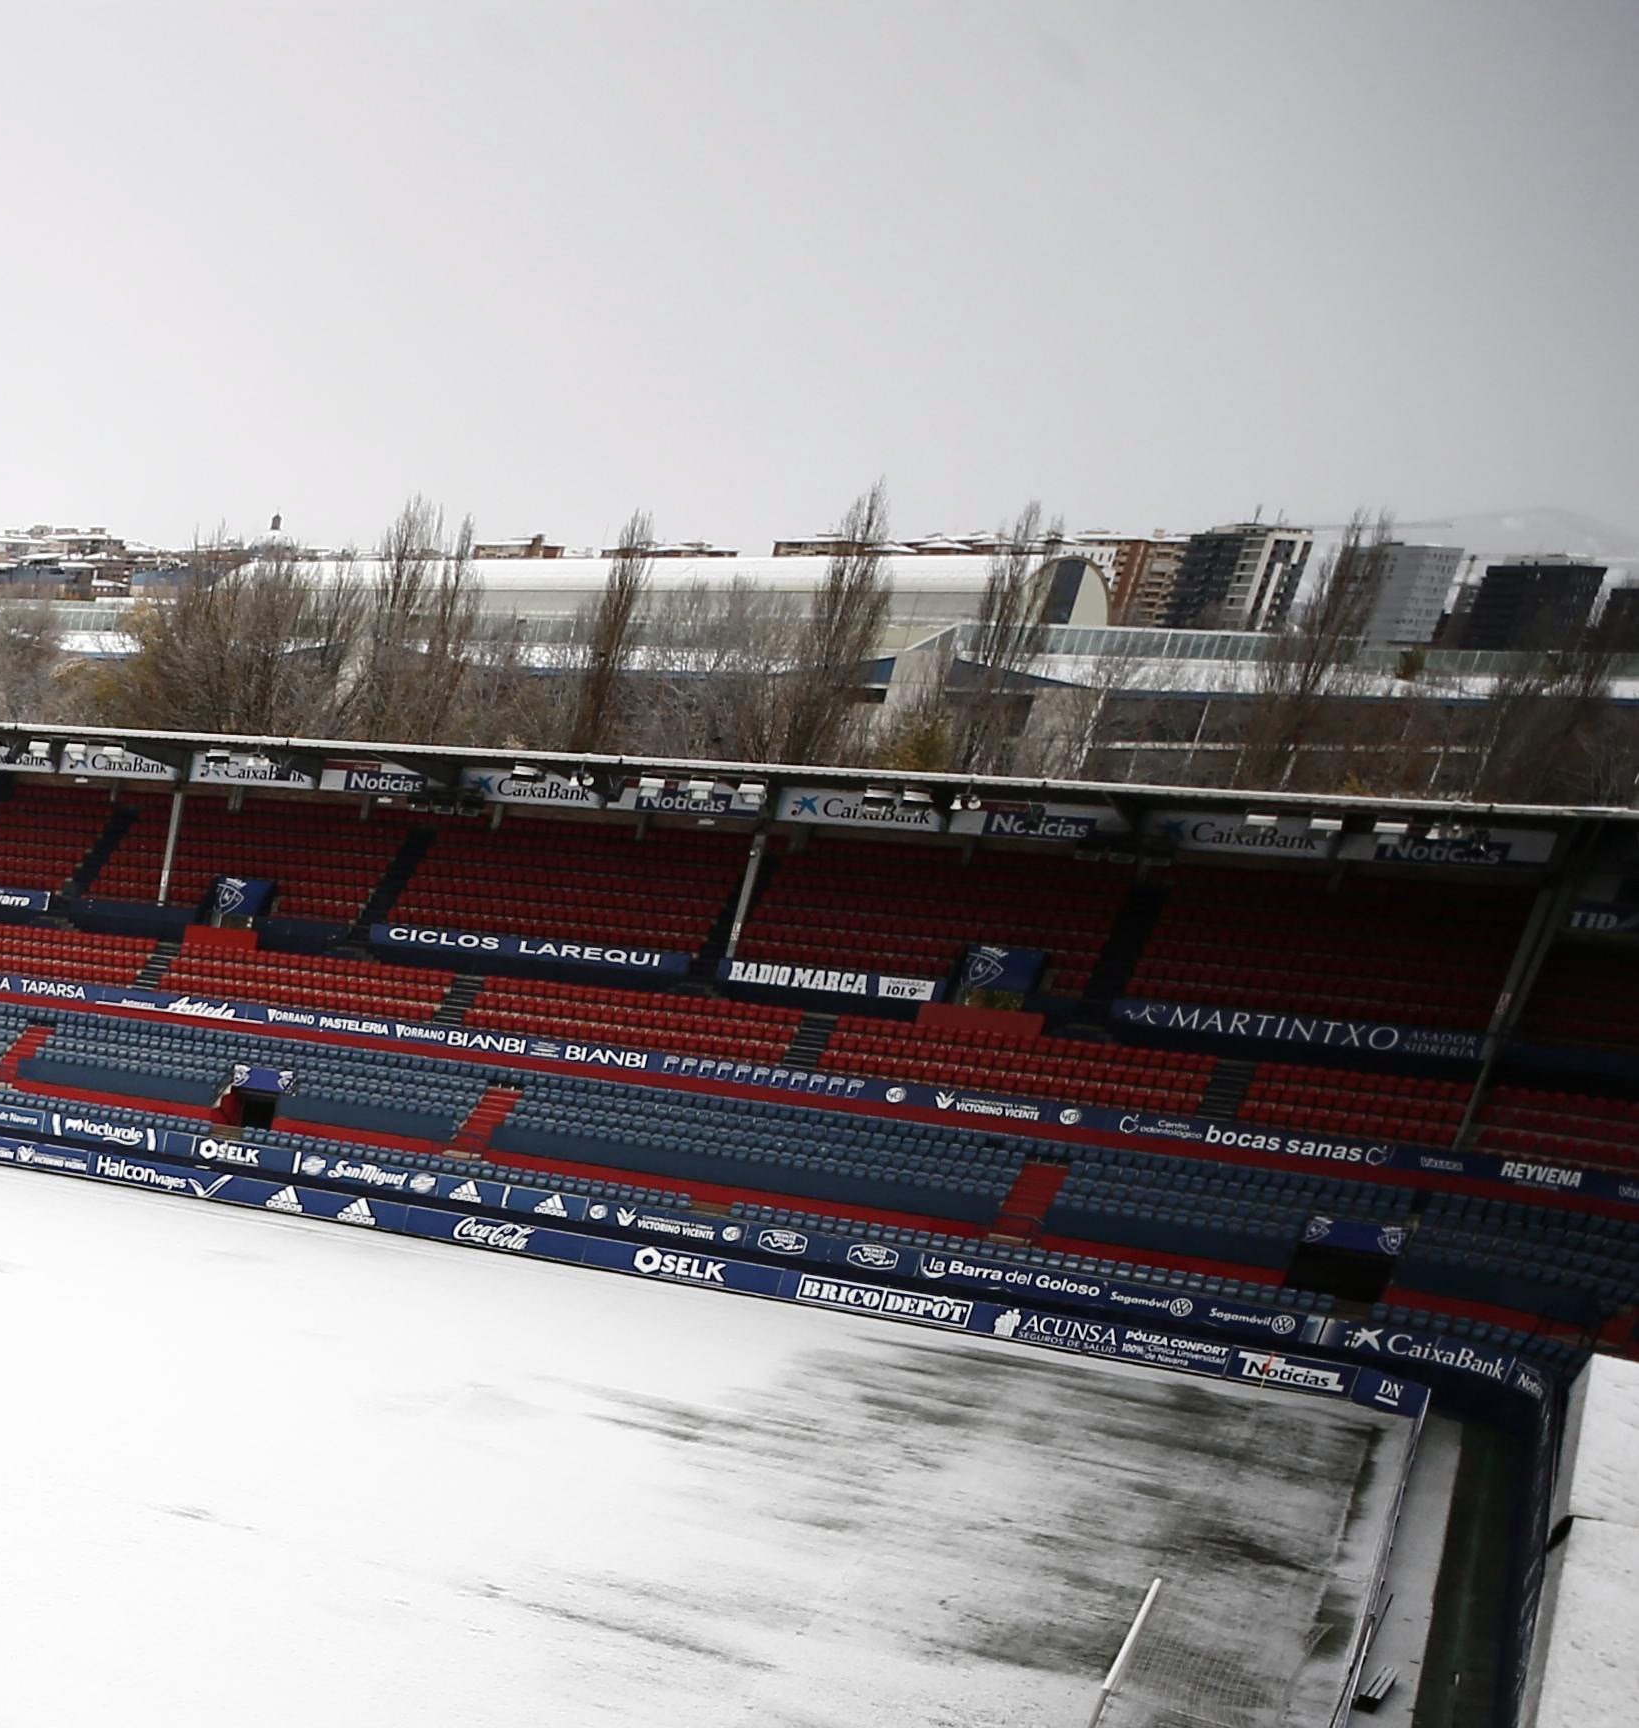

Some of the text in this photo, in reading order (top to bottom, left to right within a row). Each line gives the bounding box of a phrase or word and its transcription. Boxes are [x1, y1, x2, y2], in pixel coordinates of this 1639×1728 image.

[92, 753, 168, 775] CaixaBank
[224, 760, 305, 784] CaixaBnk
[349, 773, 424, 793] Noticias
[498, 777, 590, 803] CaixaBank
[990, 813, 1089, 838] Noicias
[389, 926, 662, 968] CICLOS LAREQUI
[21, 979, 86, 1000] TAPARSA
[728, 960, 868, 995] RADIO MARCA
[319, 1016, 389, 1036] PASTELERIA
[1168, 1004, 1399, 1051] MARTINTXO
[447, 1029, 526, 1055] BIANBI
[1410, 1029, 1478, 1048] ASADOR
[564, 1044, 648, 1070] BIANBI
[0, 1111, 9, 1122] de
[9, 1113, 38, 1127] Navarra
[955, 1101, 1041, 1122] VICTORINO VICENTE
[83, 1118, 145, 1145] lacturale
[1138, 1123, 1202, 1140] odontológico
[1157, 1118, 1191, 1131] Centro
[220, 1143, 260, 1166] SELK
[1204, 1123, 1363, 1163] bocas sanas
[1501, 1160, 1583, 1188] REYVENA
[265, 1198, 304, 1214] adidas
[449, 1190, 482, 1204] adidas
[336, 1211, 377, 1226] adidas
[534, 1204, 569, 1219] adidas
[636, 1218, 716, 1242] VICTORINO VICENTE
[661, 1253, 727, 1283] SELK
[928, 1257, 1101, 1297] la Barra del Goloso
[801, 1277, 881, 1310] BRICO
[1110, 1291, 1170, 1310] Sagamóvil
[1209, 1307, 1272, 1327] Sagamóvil
[1022, 1313, 1118, 1346] ACUNSA
[1018, 1330, 1117, 1355] SEGUROS DE SALUD
[1125, 1329, 1230, 1357] PÓLIZA CONFORT
[1144, 1351, 1189, 1367] de Navarra
[1176, 1348, 1226, 1365] Universidad
[1387, 1333, 1505, 1381] CaixaBank
[1247, 1360, 1330, 1389] Noticias
[1378, 1379, 1404, 1400] DN
